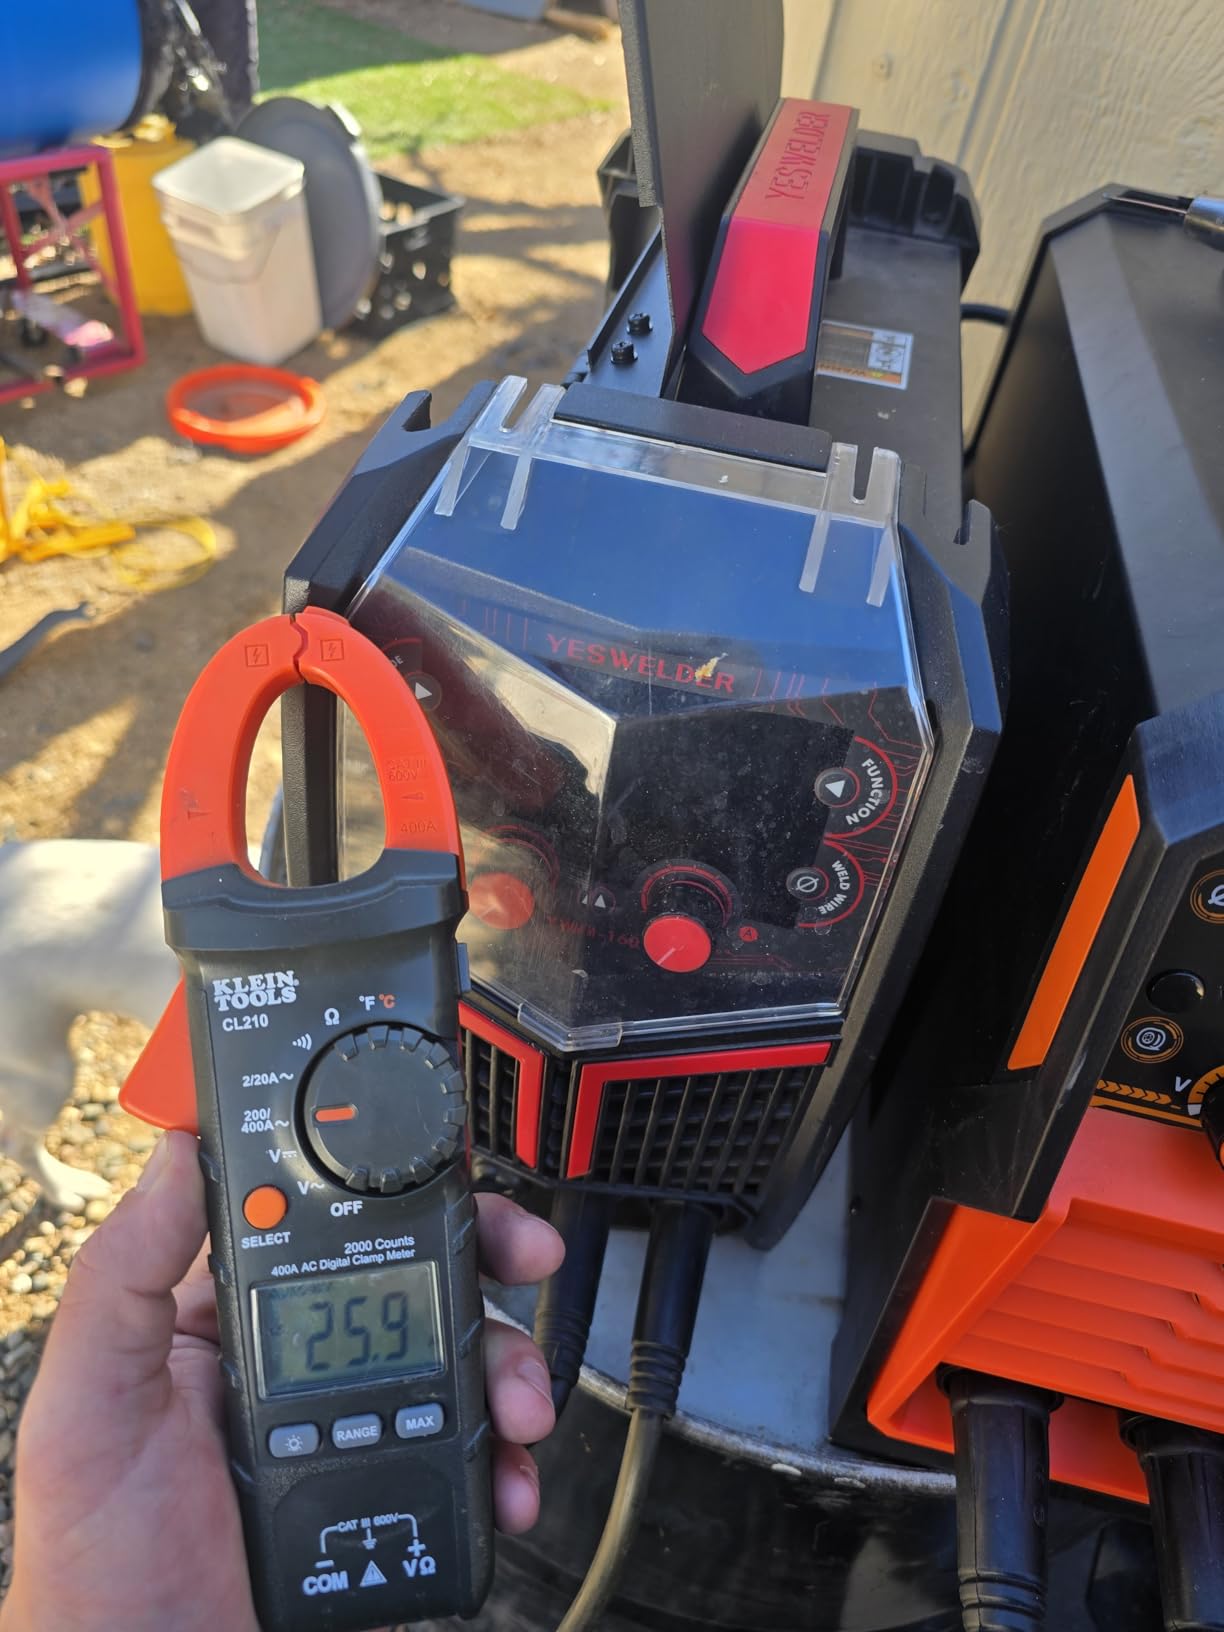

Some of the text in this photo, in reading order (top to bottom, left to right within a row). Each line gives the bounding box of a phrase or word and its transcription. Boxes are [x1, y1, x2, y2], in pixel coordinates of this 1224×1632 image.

[765, 112, 830, 199] YESWELDER
[845, 758, 884, 825] FUNCTION
[400, 820, 437, 833] 400A
[818, 860, 850, 915] WELD WIRE
[212, 970, 295, 996] KLEIN
[214, 986, 297, 1012] TOOLS
[222, 1013, 269, 1032] CL210
[1175, 1076, 1192, 1092] V
[243, 1107, 271, 1122] 200/
[330, 1200, 363, 1217] OFF
[241, 1231, 291, 1249] SELECT
[344, 1235, 415, 1254] 2000 Counts
[271, 1248, 416, 1277] 400A AC Digital Clamp Meter
[306, 1290, 409, 1371] 25.9
[405, 1415, 435, 1430] MAX
[336, 1425, 378, 1441] RANGE
[337, 1519, 358, 1532] CAT
[373, 1512, 399, 1526] 600V
[303, 1570, 349, 1595] COM
